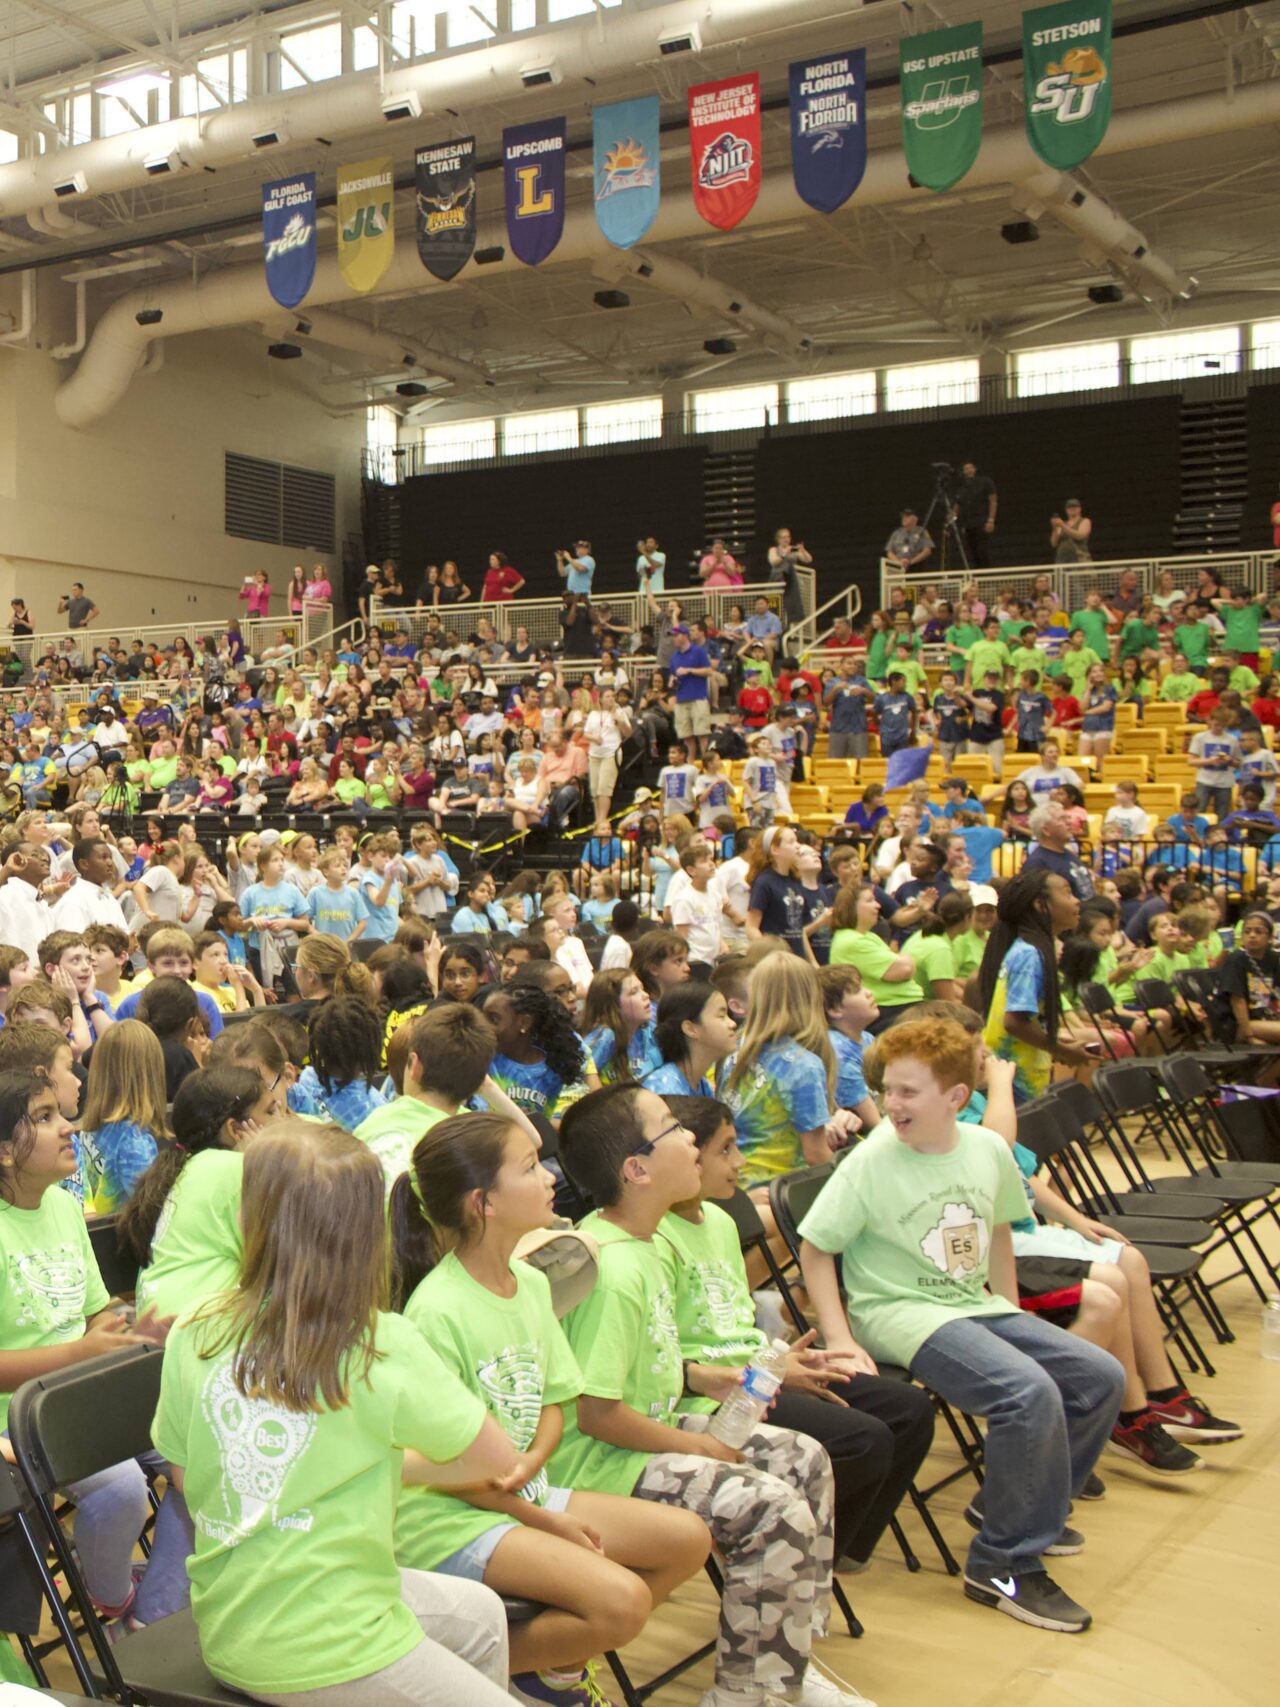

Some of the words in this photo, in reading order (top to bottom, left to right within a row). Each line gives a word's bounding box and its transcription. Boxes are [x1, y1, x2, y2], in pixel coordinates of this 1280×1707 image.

[1032, 17, 1101, 46] STETSON
[805, 59, 849, 80] NORTH
[903, 59, 926, 74] USC
[928, 46, 980, 67] UPSTATE
[694, 92, 716, 108] NEW
[717, 83, 754, 101] JERSEY
[800, 72, 855, 96] FLORIDA
[691, 98, 740, 117] INSTITUTE
[742, 93, 756, 107] OF
[808, 92, 847, 113] NORTH
[1031, 72, 1099, 123] SU
[692, 104, 756, 128] TECHNOLOGY
[799, 101, 858, 133] FLORIDA
[416, 141, 473, 165] KENNESAW
[506, 136, 563, 160] LIPSCOMB
[429, 157, 462, 175] STATE
[709, 146, 746, 176] NJIT
[271, 182, 306, 200] FLORIDA
[338, 171, 392, 195] JACKSONVILLE
[515, 164, 555, 220] L
[264, 197, 284, 212] GULF
[286, 190, 313, 207] COAST
[343, 202, 391, 242] JU
[265, 225, 312, 262] FGCU
[951, 1238, 973, 1255] Es
[256, 1427, 287, 1449] Best
